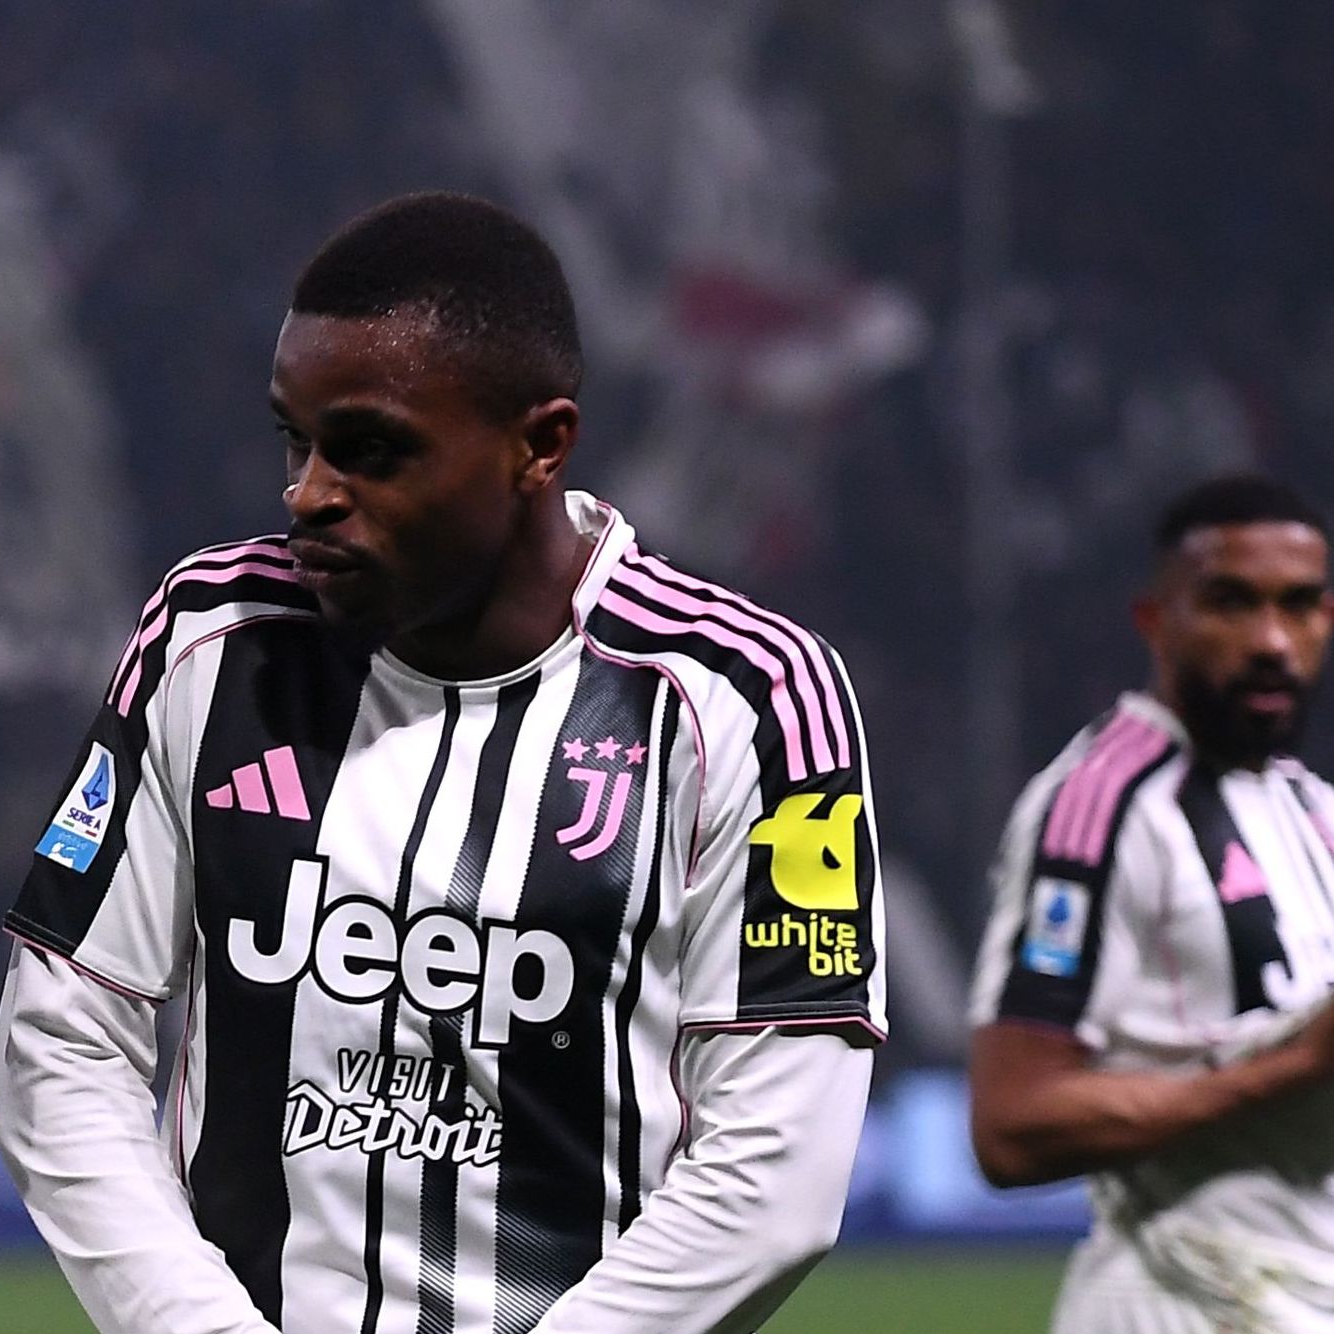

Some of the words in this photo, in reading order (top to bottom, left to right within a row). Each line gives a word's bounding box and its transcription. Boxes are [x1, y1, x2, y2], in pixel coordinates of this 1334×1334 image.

[66, 806, 95, 827] SERIE
[94, 818, 102, 831] A
[227, 860, 575, 1044] Jeep
[745, 912, 857, 948] white
[808, 945, 862, 976] bit
[339, 1050, 456, 1102] VISIT
[286, 1081, 504, 1166] Detroit
